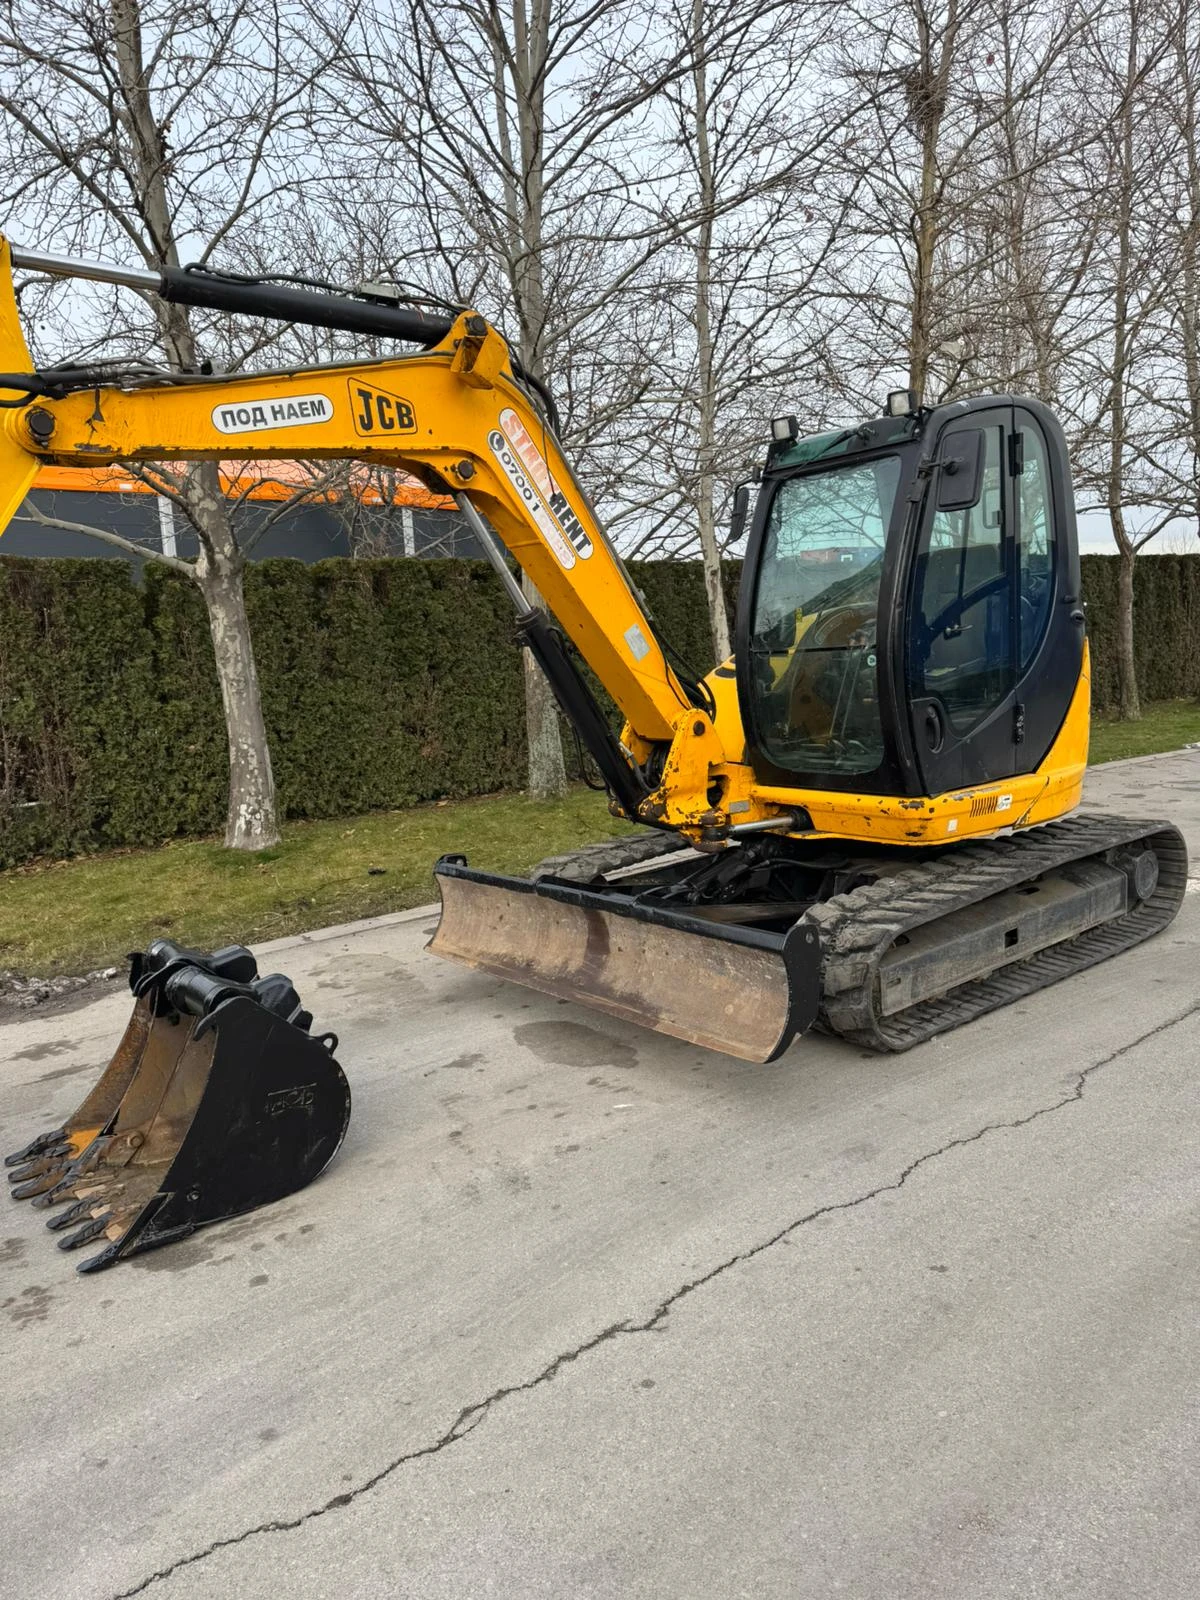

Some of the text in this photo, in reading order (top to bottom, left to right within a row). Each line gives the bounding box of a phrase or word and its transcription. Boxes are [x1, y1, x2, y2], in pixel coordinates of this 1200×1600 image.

[221, 400, 326, 427] ПОД НАЕМ
[357, 388, 415, 431] JCB
[501, 452, 533, 501] 0700
